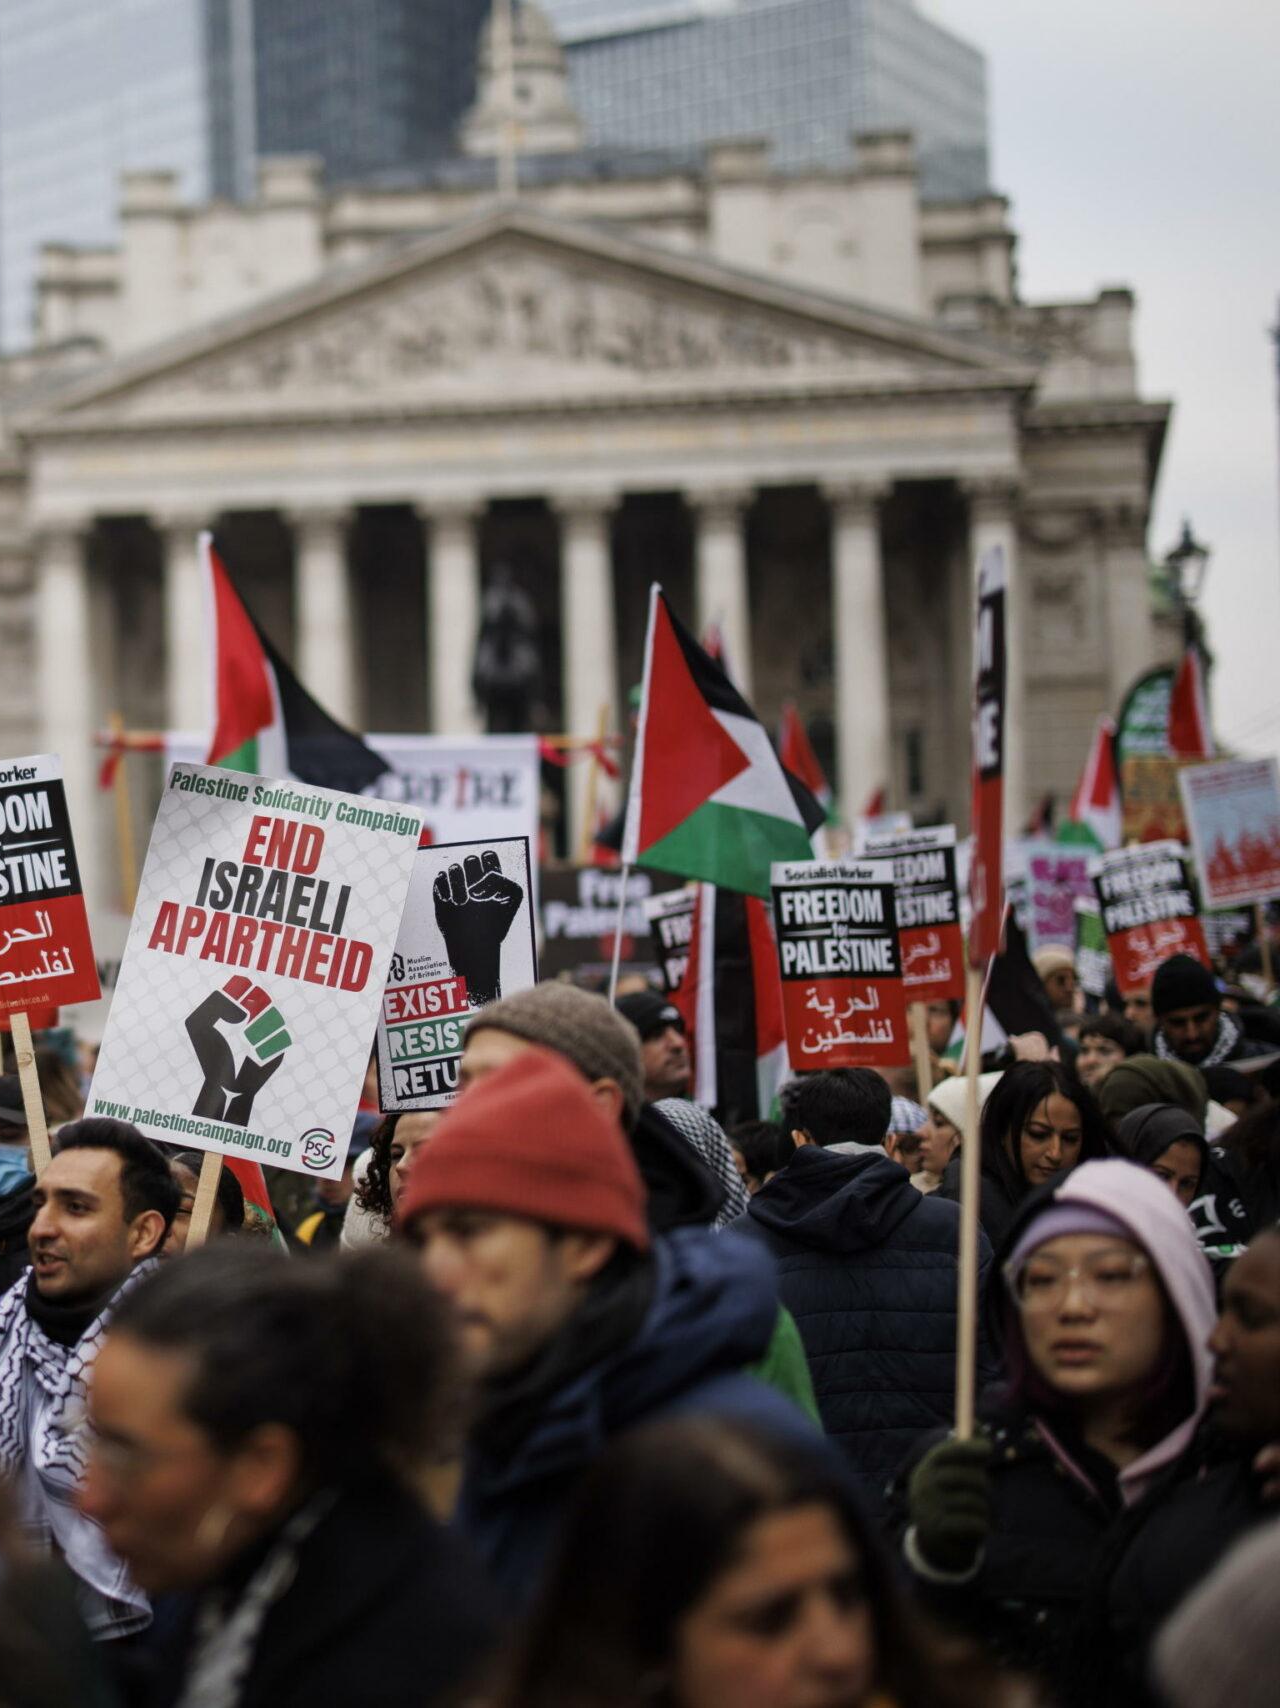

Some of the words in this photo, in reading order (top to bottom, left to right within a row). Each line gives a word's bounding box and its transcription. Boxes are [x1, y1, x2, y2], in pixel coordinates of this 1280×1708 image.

[170, 771, 248, 802] Palestine
[252, 785, 333, 821] Solidarity
[335, 802, 421, 836] Campaign
[242, 815, 326, 876] END
[195, 857, 352, 935] ISRAELI
[780, 888, 884, 926] FREEDOM
[148, 901, 374, 993] APARTHEID
[407, 955, 431, 965] Muslim
[781, 938, 895, 975] PALESTINE
[408, 961, 447, 972] Association
[417, 970, 441, 979] Britain
[384, 981, 467, 1020] EXIST.
[393, 1060, 461, 1097] RETU
[93, 1099, 292, 1158] www.palestinecampaign.org
[304, 1140, 332, 1160] PSC
